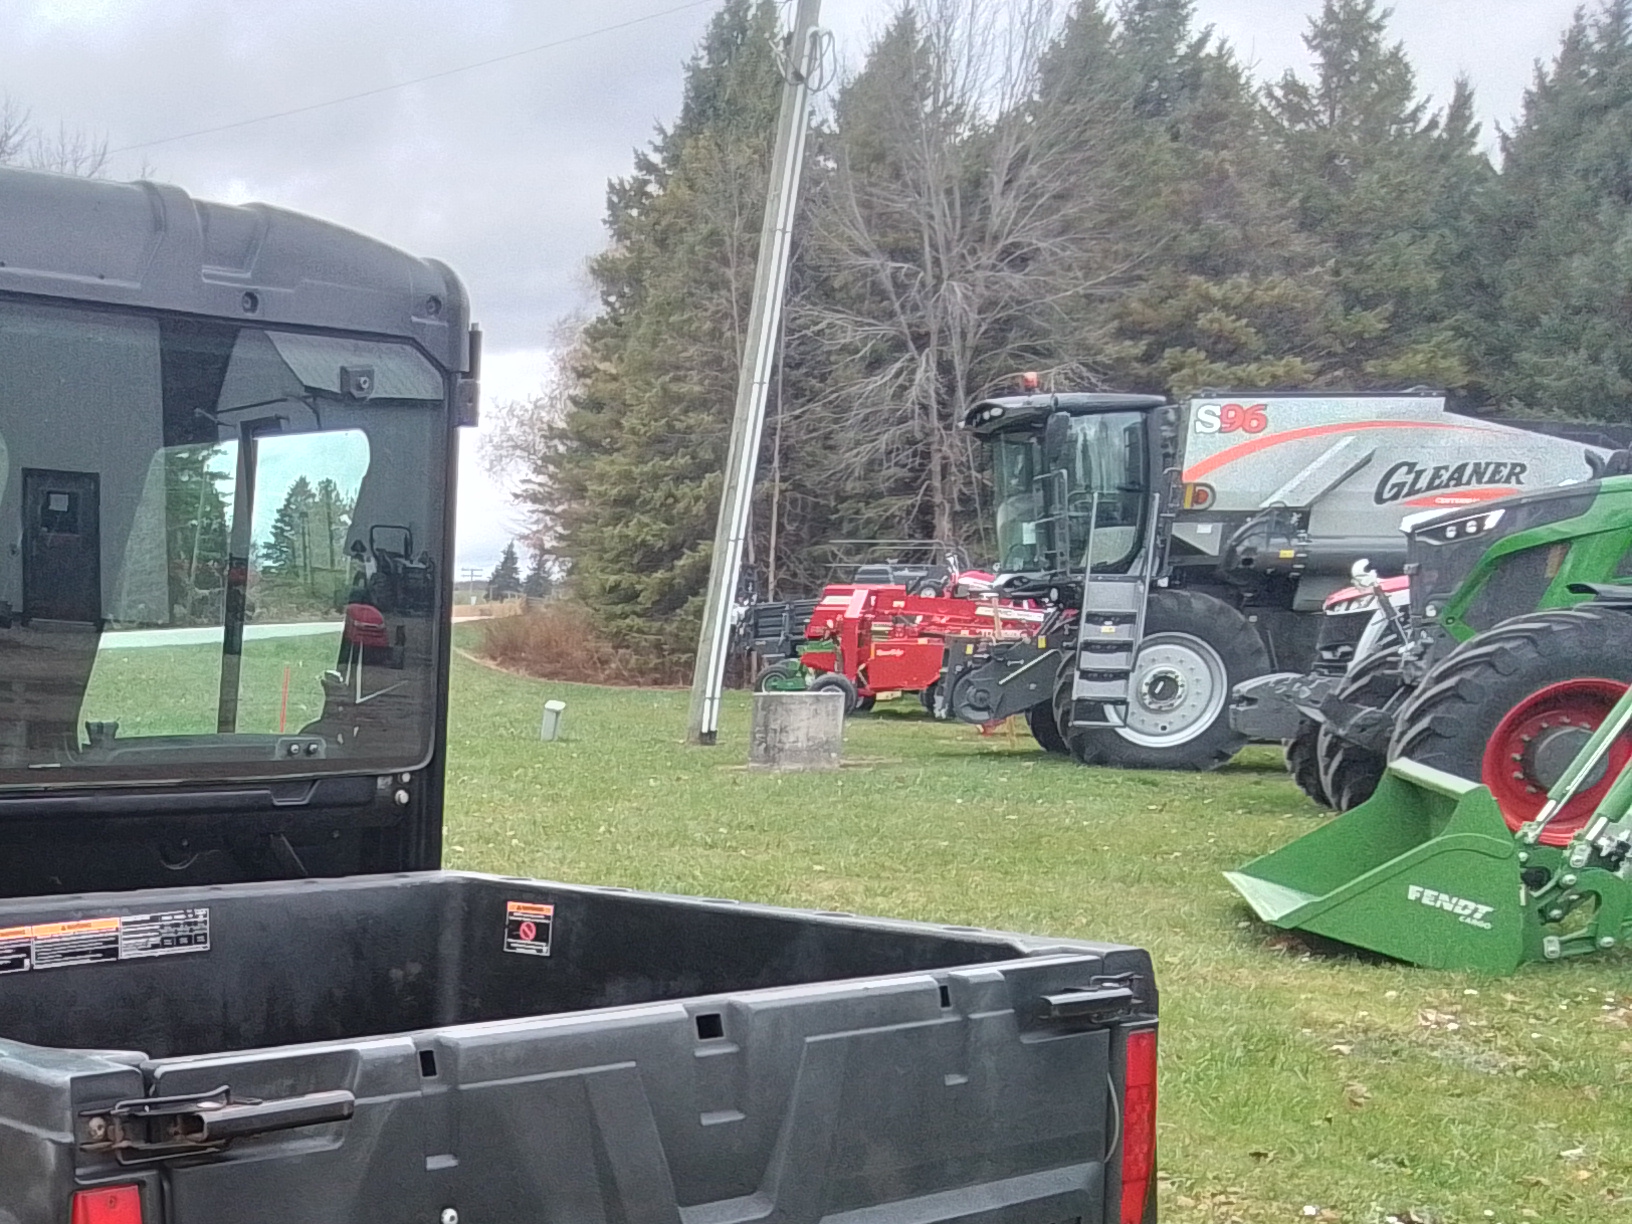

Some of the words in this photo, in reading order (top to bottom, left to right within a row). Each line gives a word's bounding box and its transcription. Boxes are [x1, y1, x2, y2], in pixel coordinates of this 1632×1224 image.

[1194, 403, 1268, 434] S96
[1374, 460, 1528, 505] GLEANER
[1407, 884, 1495, 919] FENDT
